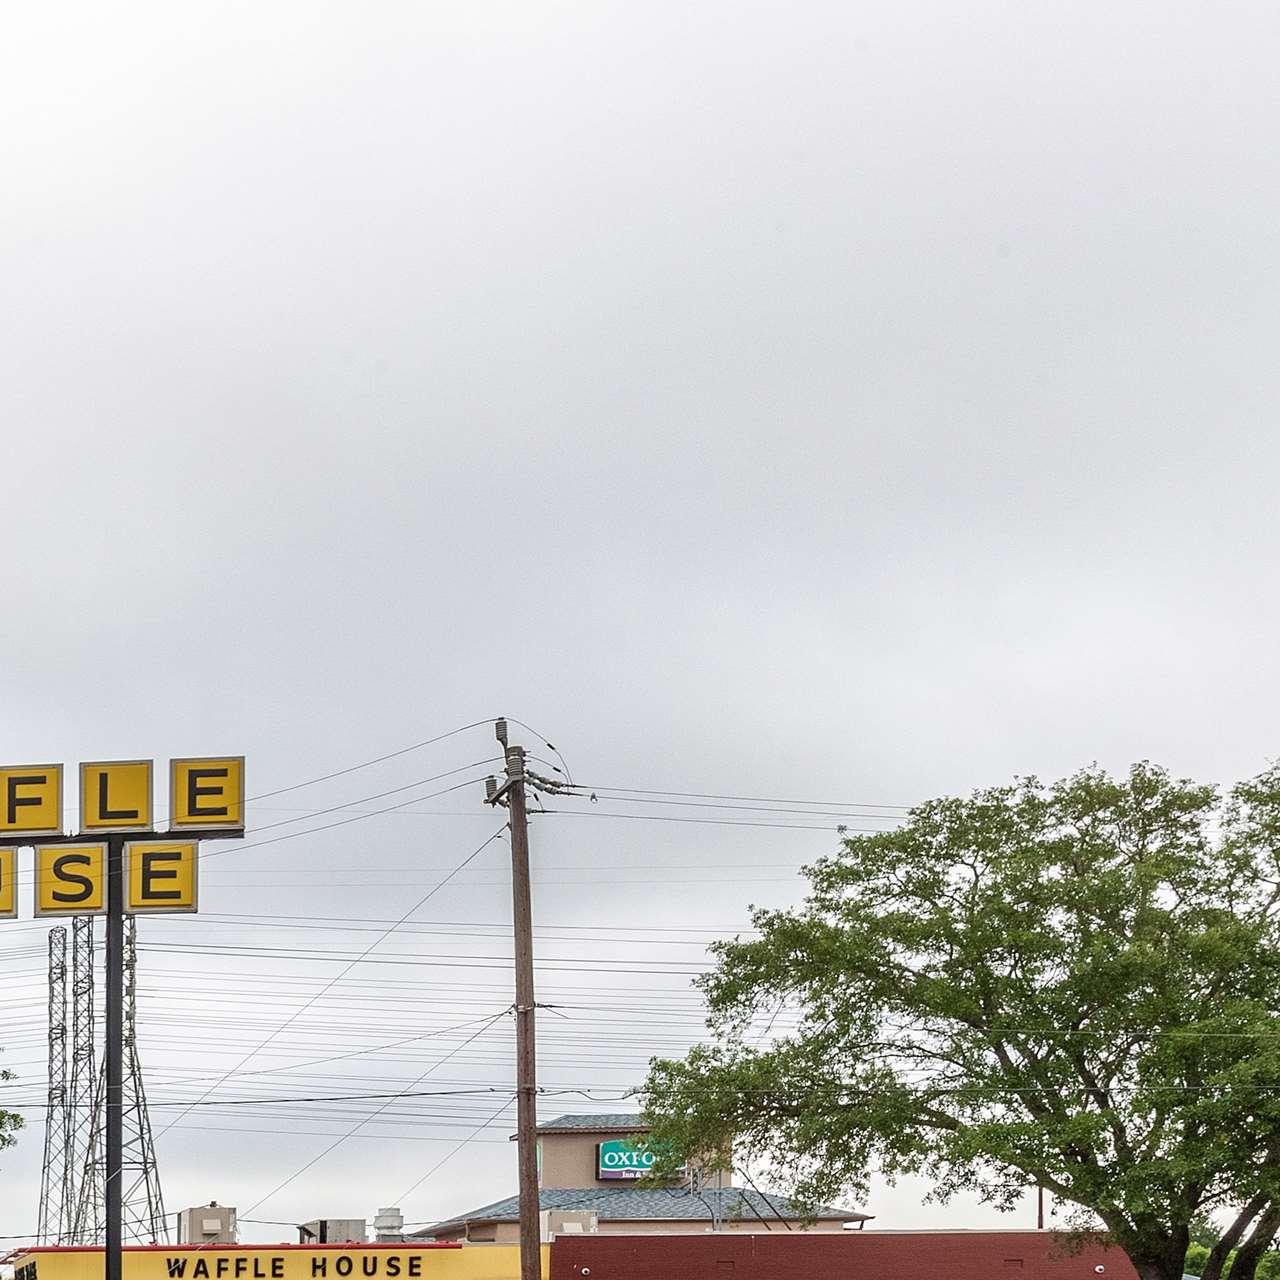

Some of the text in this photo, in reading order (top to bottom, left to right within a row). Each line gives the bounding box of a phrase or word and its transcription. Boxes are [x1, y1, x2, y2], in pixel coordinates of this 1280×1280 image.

[604, 1151, 657, 1166] OXFO
[166, 1255, 423, 1279] WAFFLE HOUSE
